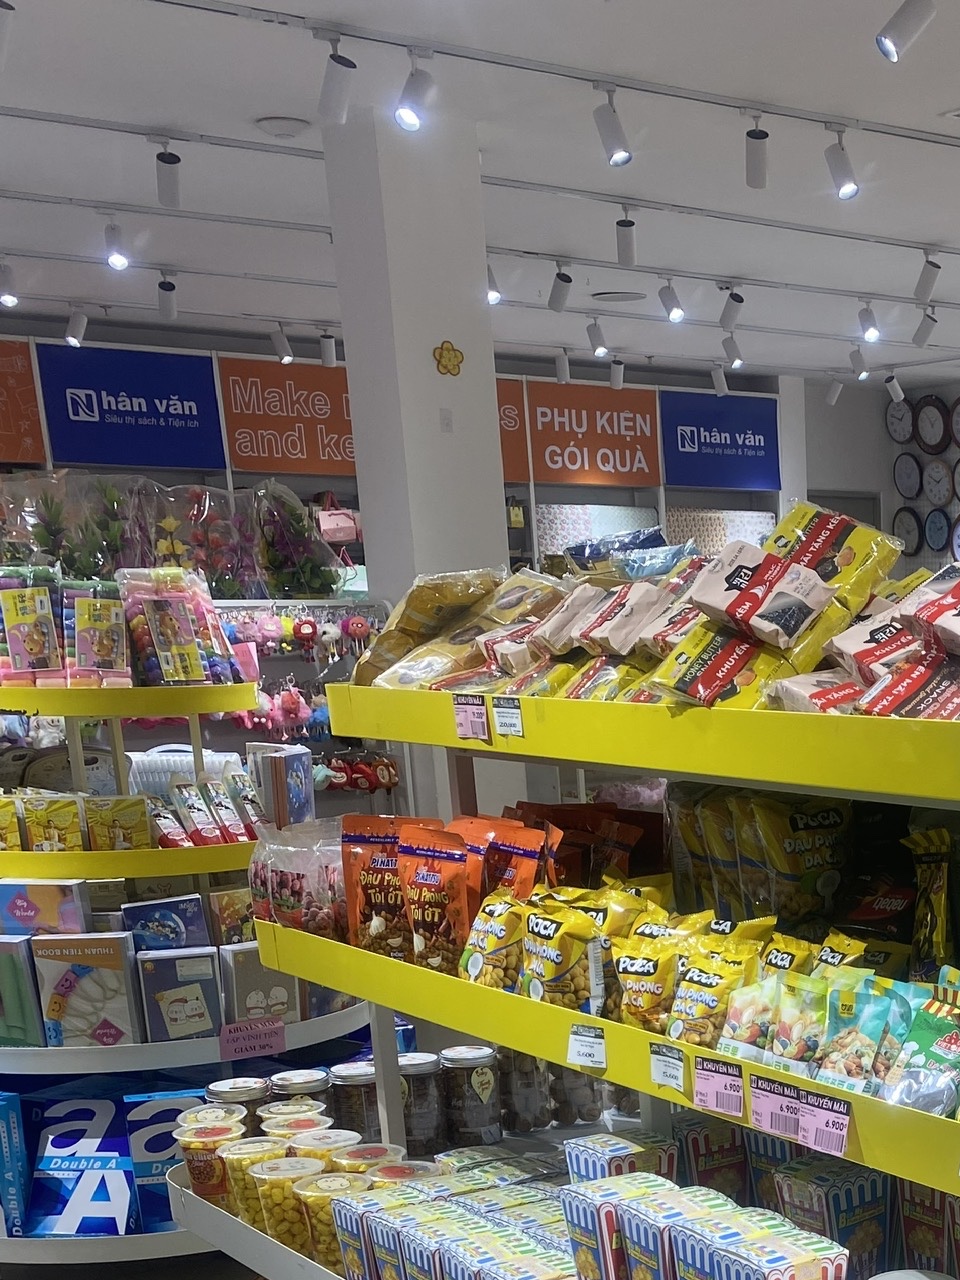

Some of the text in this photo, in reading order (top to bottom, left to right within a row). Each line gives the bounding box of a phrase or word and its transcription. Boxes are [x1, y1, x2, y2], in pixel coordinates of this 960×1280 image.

[153, 394, 198, 416] văn
[230, 377, 331, 418] Make
[537, 407, 587, 439] PHỤ
[597, 411, 651, 441] KIỆN
[235, 424, 307, 459] and
[737, 430, 765, 447] văn
[545, 441, 650, 474] GÓI QUÀ
[619, 957, 655, 974] POCA
[767, 949, 792, 968] POCA
[819, 947, 843, 965] POCA
[685, 967, 722, 986] POCA
[50, 1157, 118, 1170] Double A
